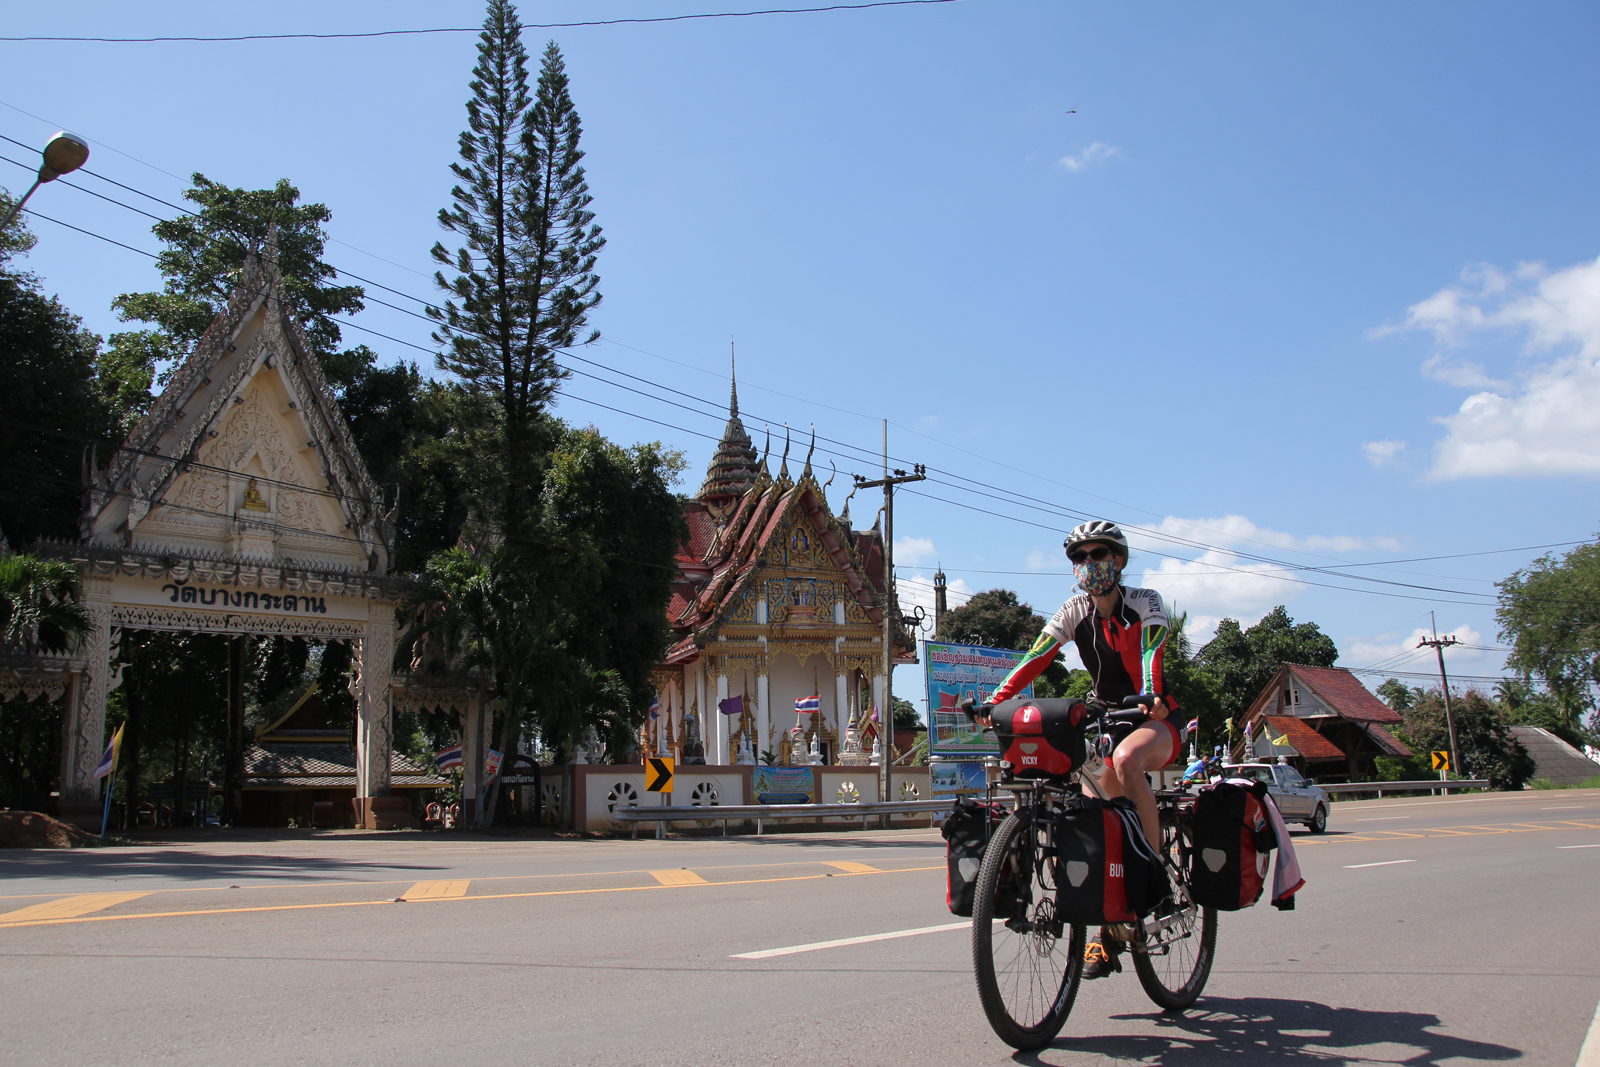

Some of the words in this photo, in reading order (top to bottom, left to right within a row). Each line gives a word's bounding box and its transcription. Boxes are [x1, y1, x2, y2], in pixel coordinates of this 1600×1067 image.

[162, 579, 327, 614] วัดบางกระดาน
[1021, 756, 1038, 765] VICKY
[1109, 863, 1125, 878] BUY
